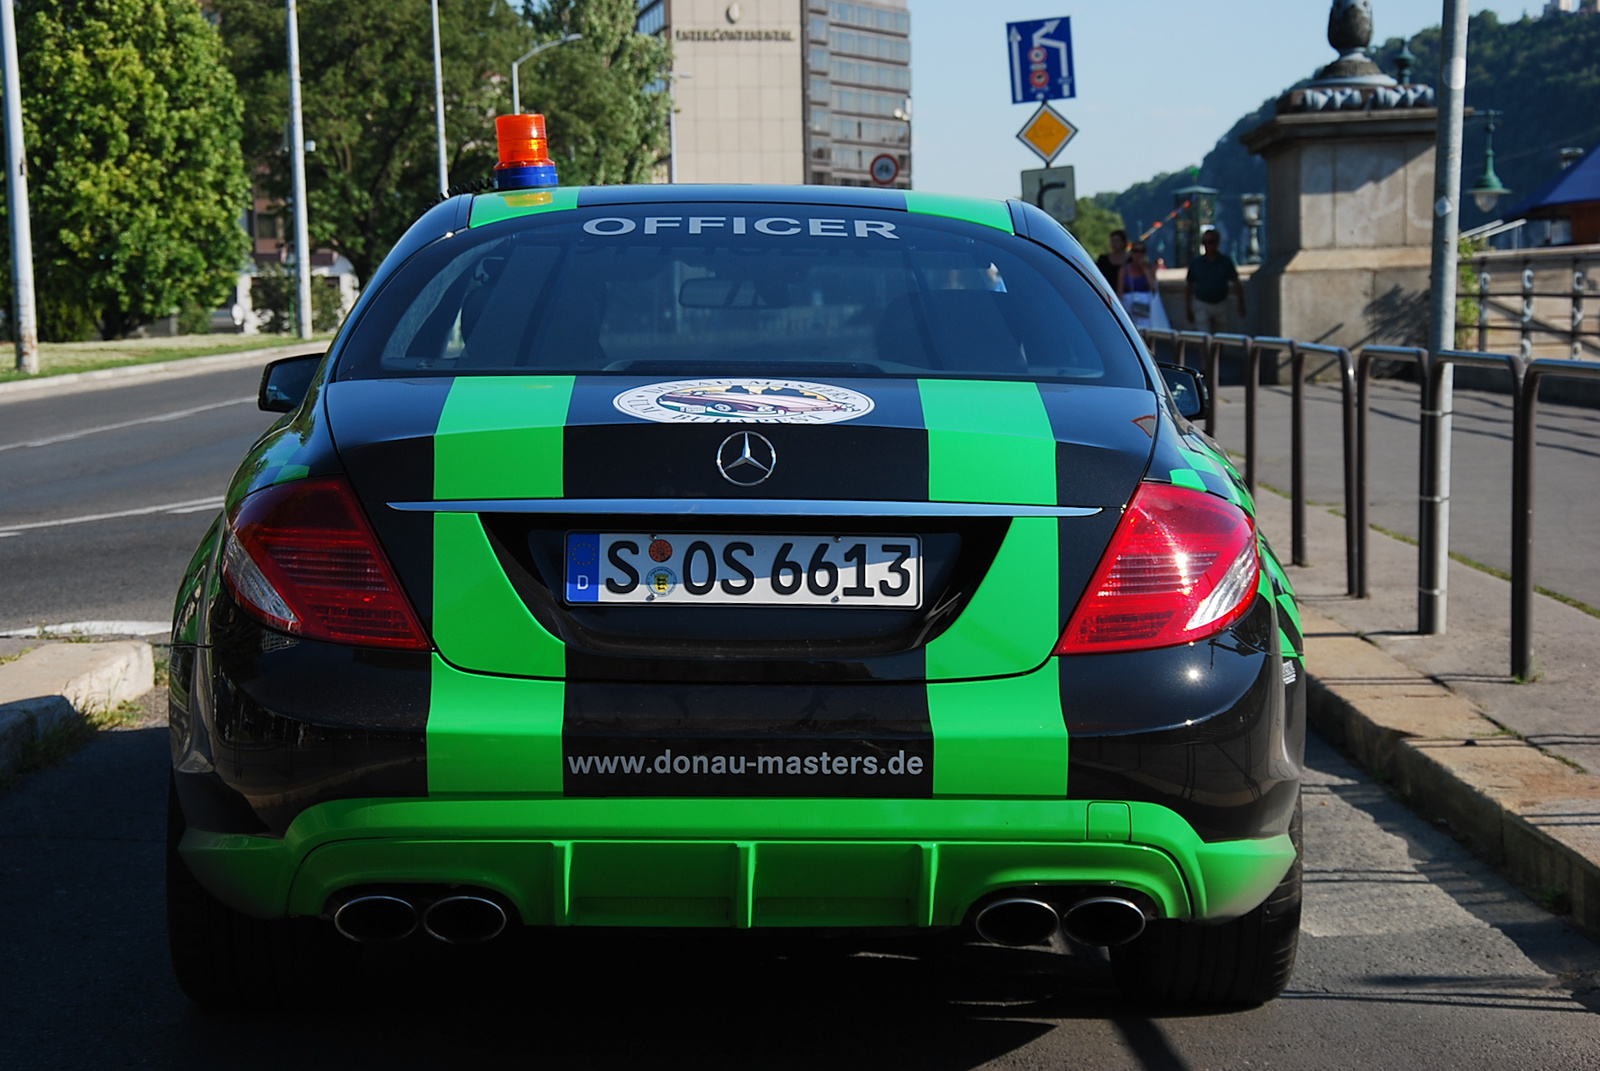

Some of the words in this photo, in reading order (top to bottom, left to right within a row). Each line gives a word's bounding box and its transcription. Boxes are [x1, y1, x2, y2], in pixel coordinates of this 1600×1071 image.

[583, 216, 900, 240] OFFICER
[643, 380, 734, 395] DONAU
[749, 380, 858, 400] MASTERS
[606, 540, 640, 594] S
[683, 540, 755, 596] OS
[771, 542, 912, 597] 6613
[576, 575, 589, 590] D
[567, 749, 924, 775] www.donau-masters.de
